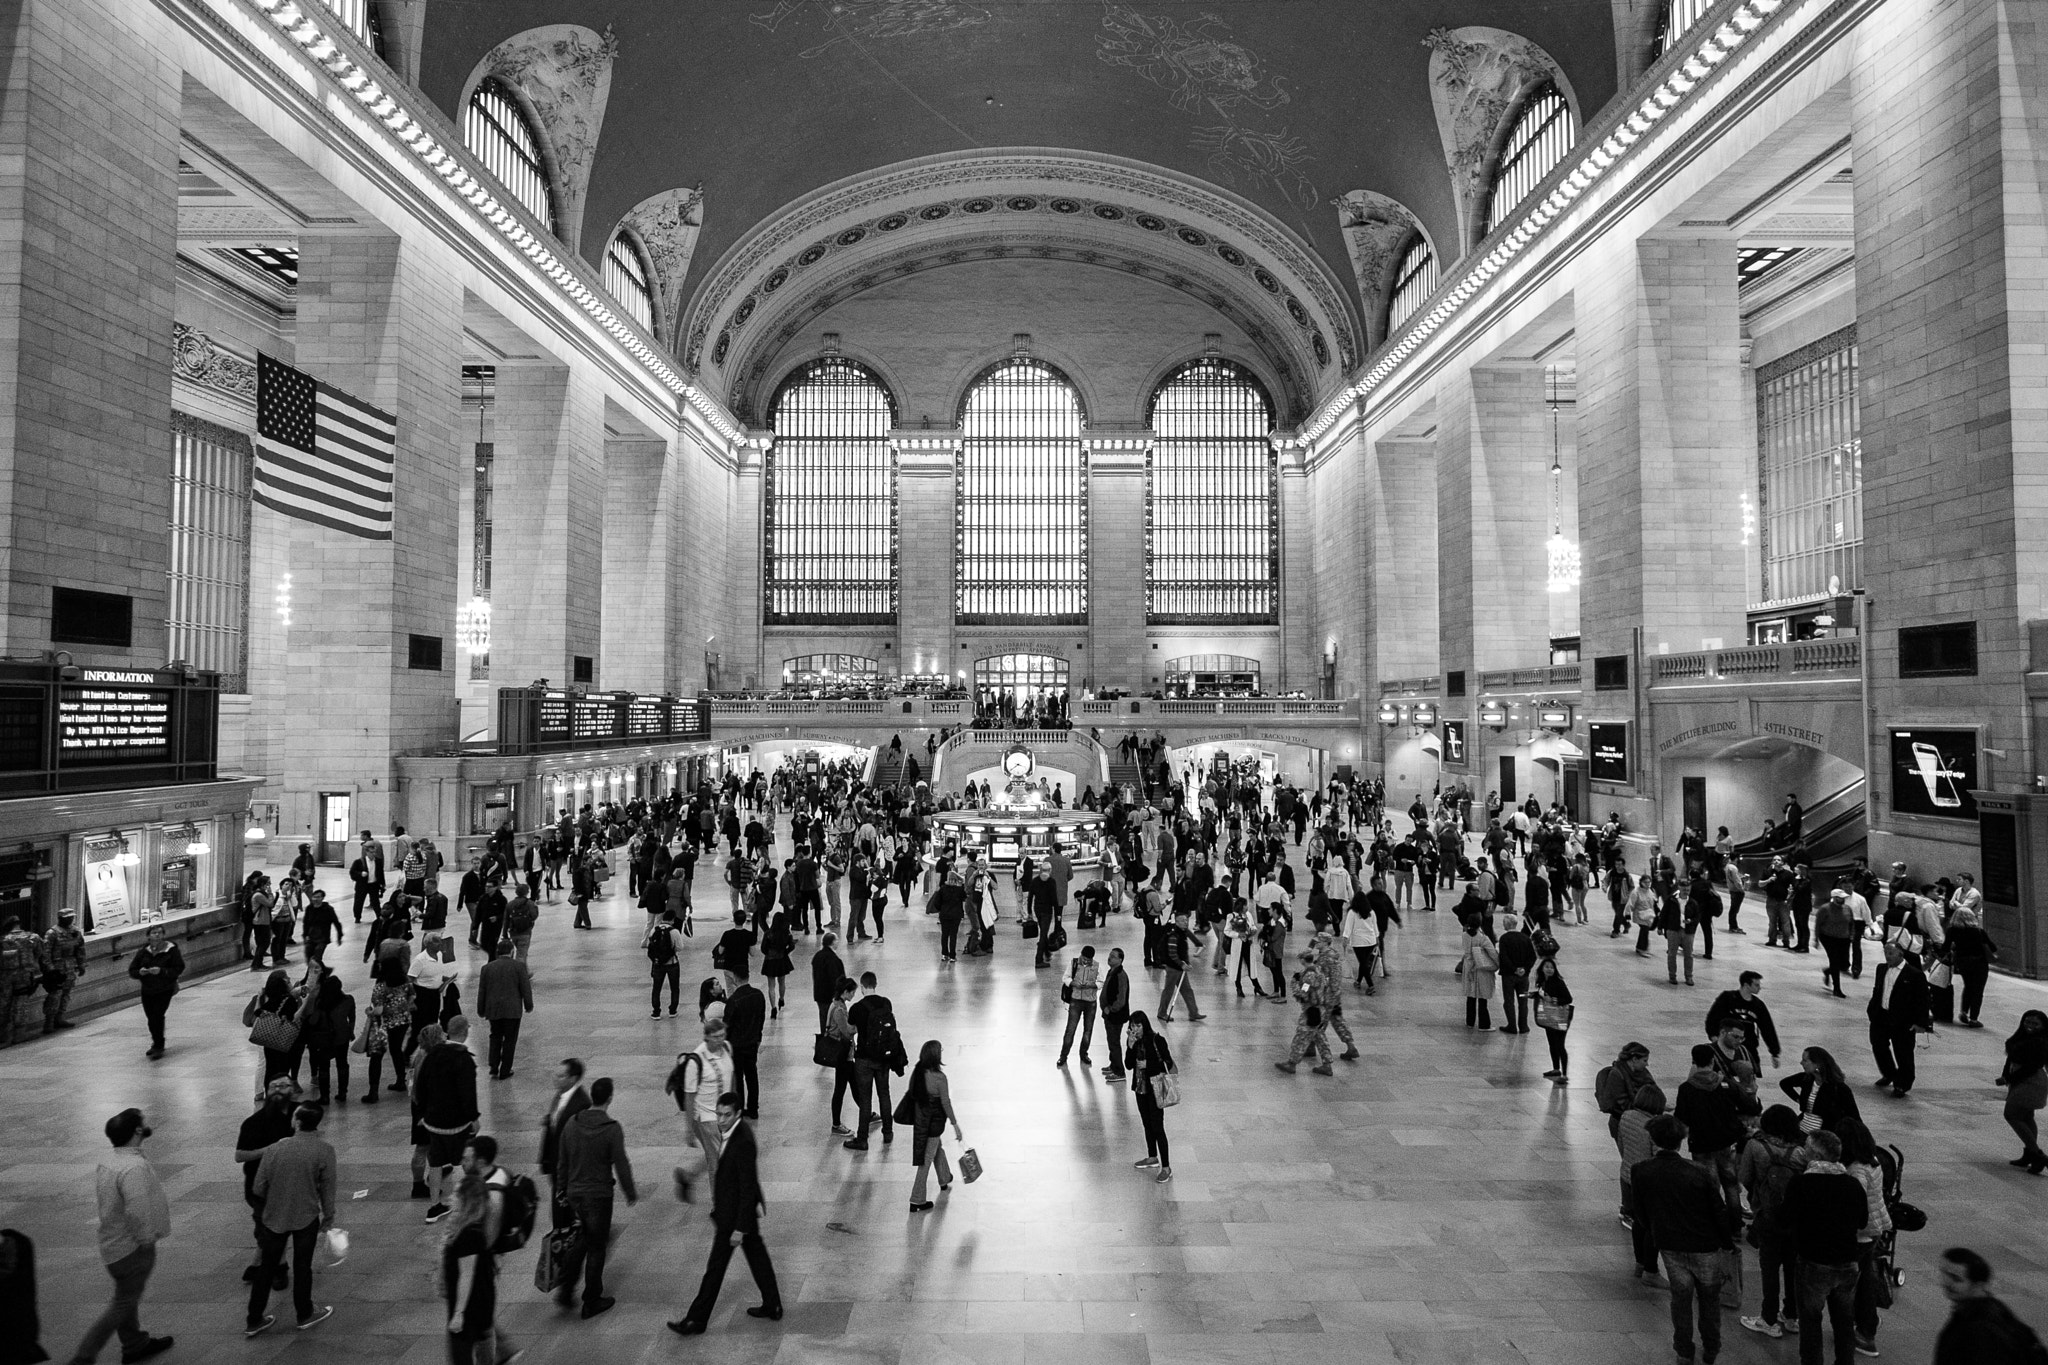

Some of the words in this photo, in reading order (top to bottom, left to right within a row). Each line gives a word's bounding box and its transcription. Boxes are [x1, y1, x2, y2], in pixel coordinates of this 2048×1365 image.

[84, 670, 154, 683] INFORMATION
[82, 690, 116, 699] Attention
[104, 704, 132, 712] packages
[60, 714, 97, 722] Unattended
[100, 714, 118, 722] items
[120, 715, 132, 723] may
[66, 726, 75, 736] By
[78, 726, 90, 734] the
[106, 726, 128, 734] Police
[130, 726, 162, 734] Department
[1659, 739, 1673, 752] THE
[1672, 727, 1702, 746] METLIFE
[1701, 720, 1737, 735] BUILDING
[1764, 722, 1786, 735] 45TH
[1788, 725, 1824, 744] STREET
[62, 739, 82, 747] Thank
[84, 739, 97, 748] you
[99, 738, 111, 746] for
[112, 739, 128, 747] your
[130, 737, 166, 746] cooperation
[723, 736, 747, 745] TICKET
[748, 732, 783, 741] MACHINES
[1953, 772, 1966, 780] edge
[174, 801, 187, 810] GCT
[189, 799, 209, 808] TOURS
